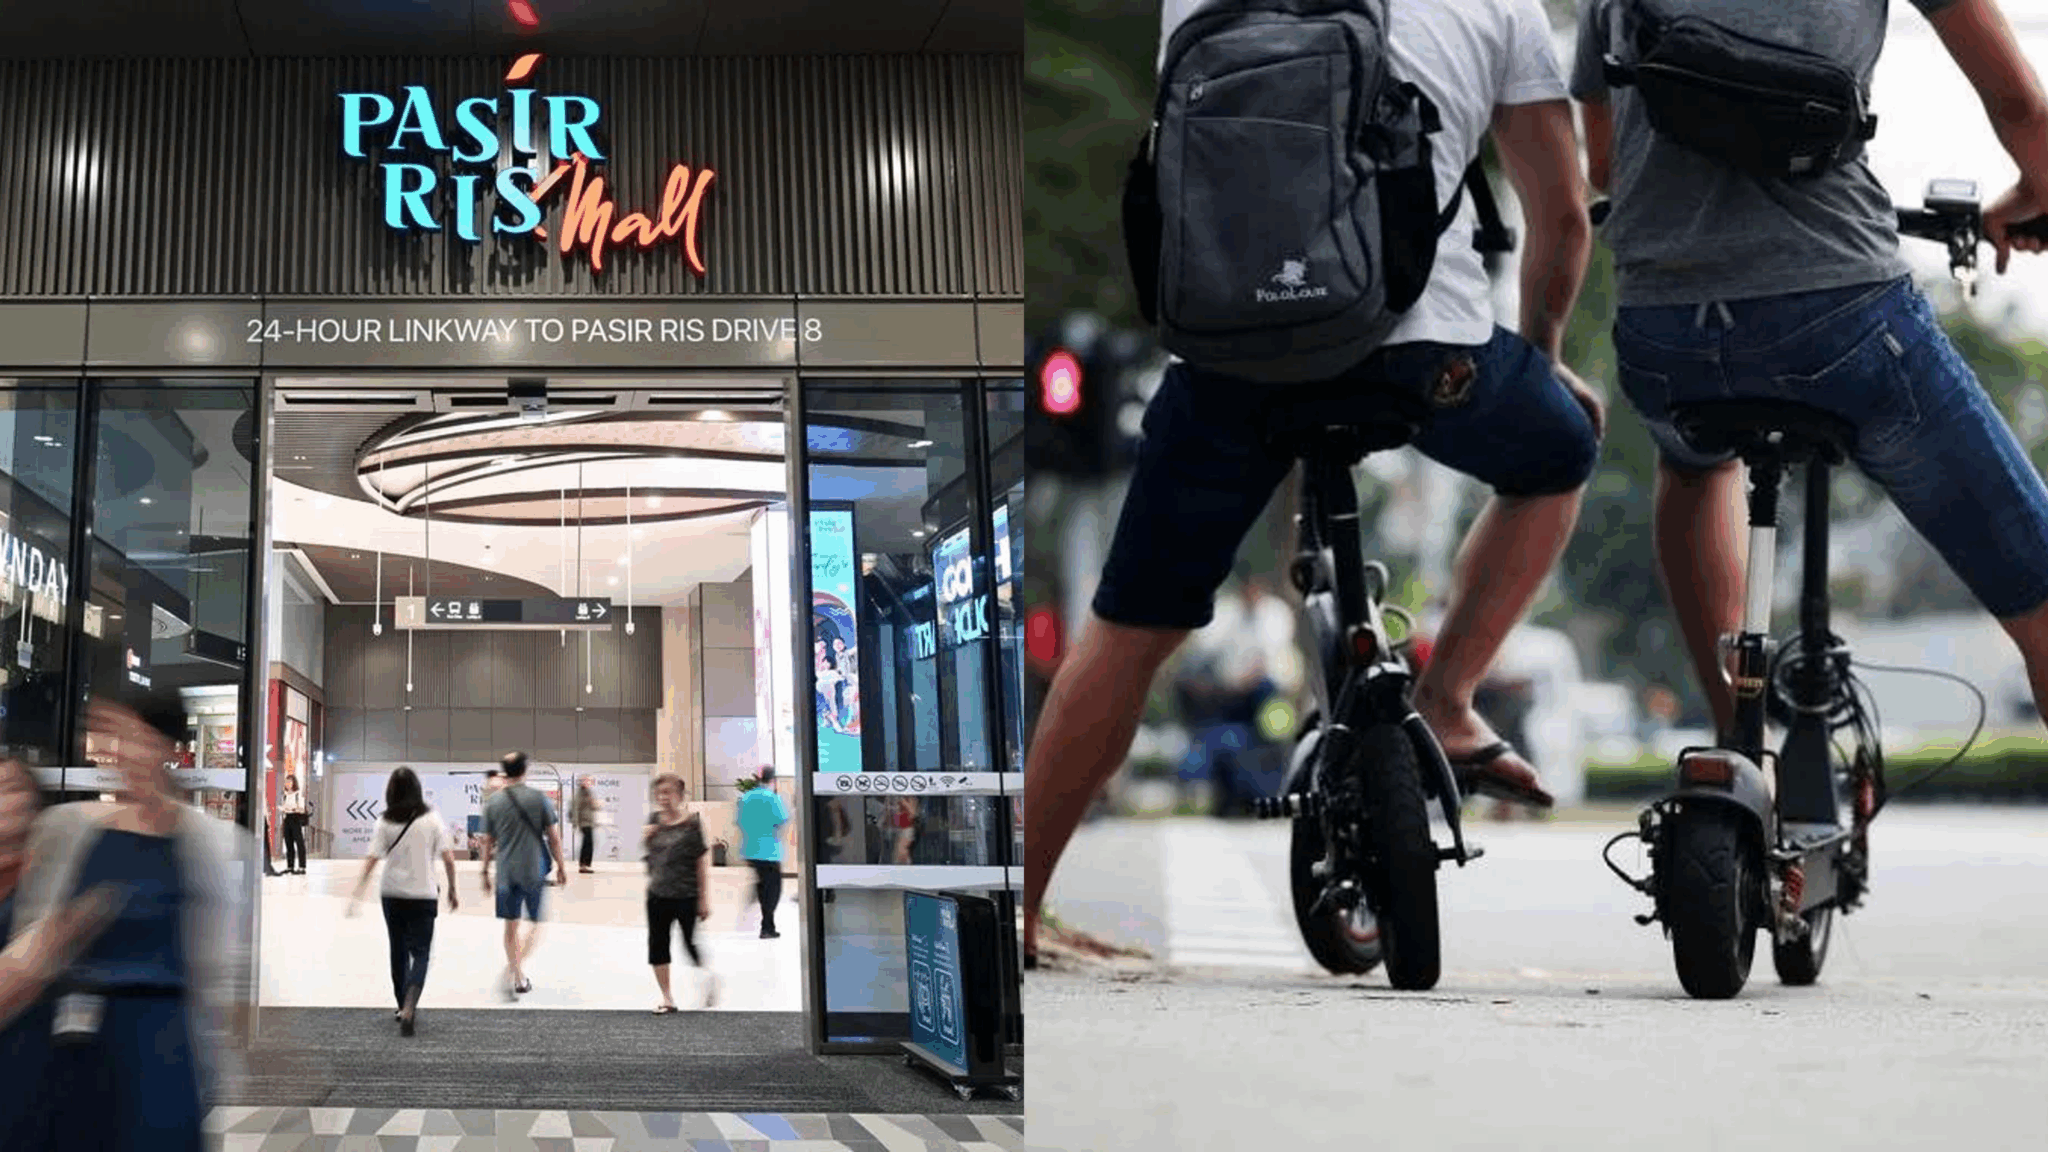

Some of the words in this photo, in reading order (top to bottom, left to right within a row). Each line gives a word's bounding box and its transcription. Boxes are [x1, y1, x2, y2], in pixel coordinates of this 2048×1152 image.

[337, 85, 606, 163] PASIR
[380, 163, 546, 241] RIS
[533, 151, 715, 272] Mall
[246, 318, 382, 343] 24-HOUR
[389, 318, 518, 343] LINKWAY
[524, 318, 564, 343] TO
[571, 318, 653, 343] PASIR
[660, 318, 705, 343] RIS
[712, 317, 796, 342] DRIVE
[804, 317, 823, 342] 8
